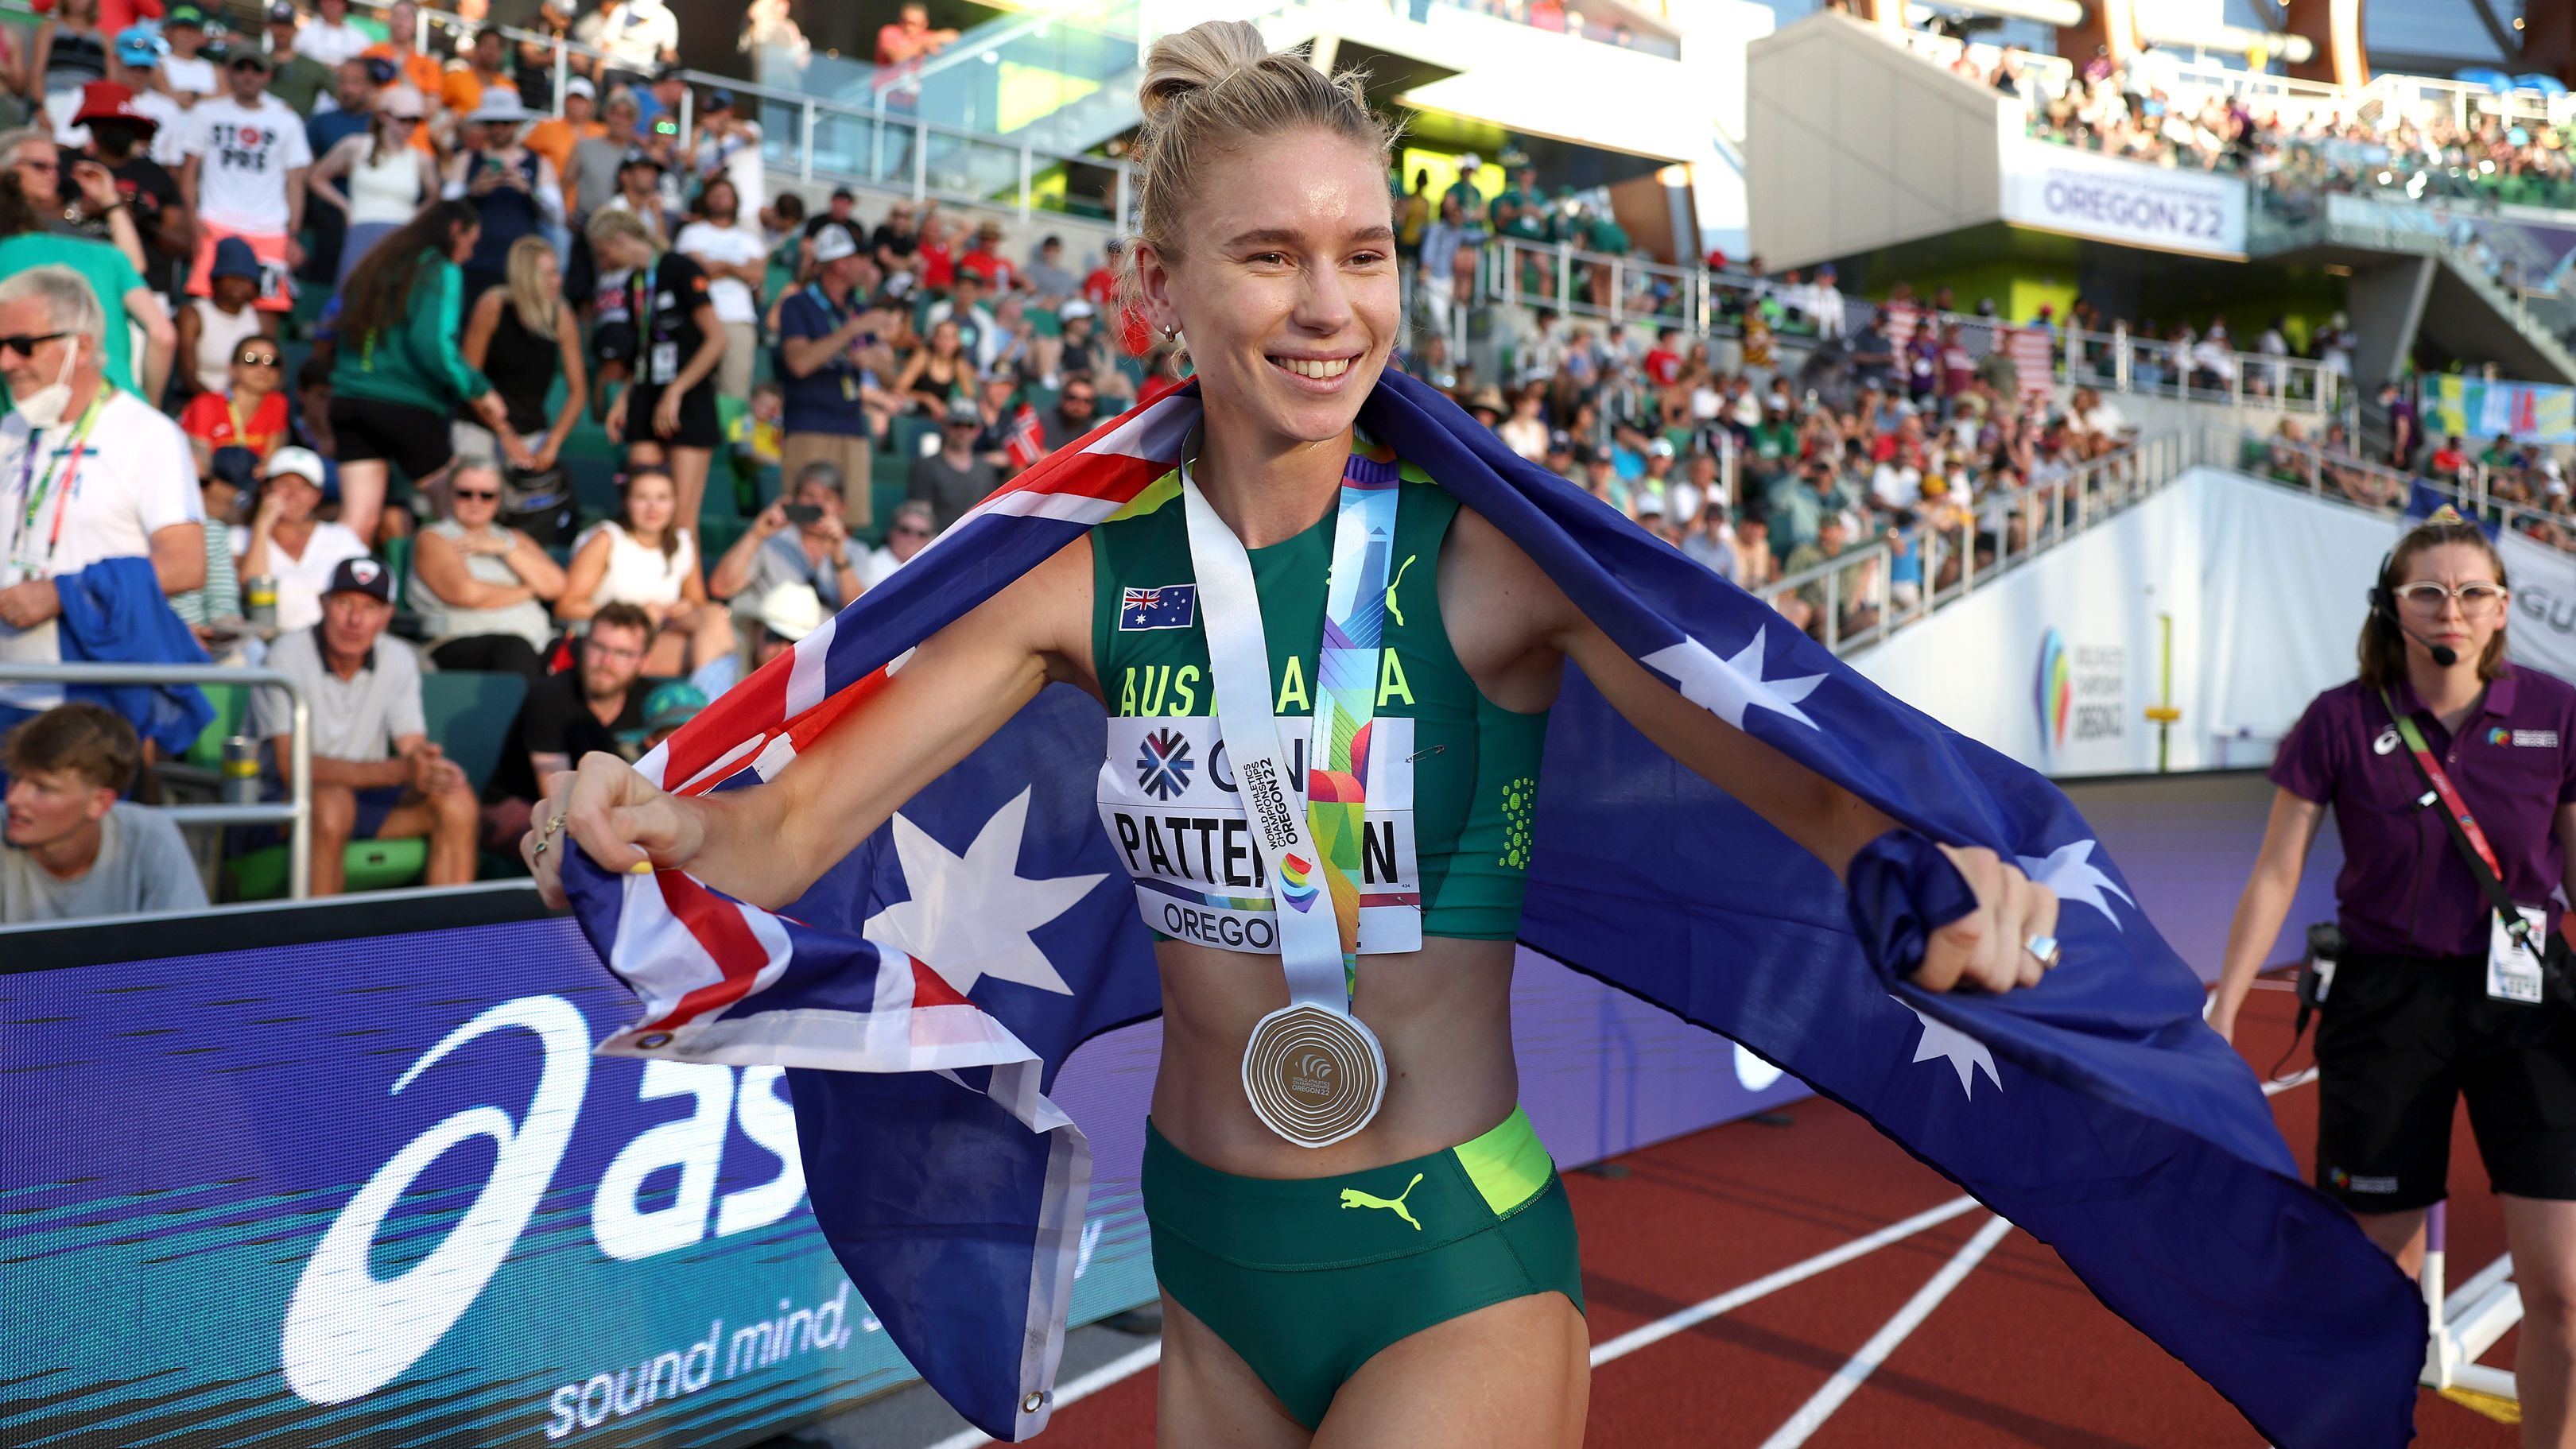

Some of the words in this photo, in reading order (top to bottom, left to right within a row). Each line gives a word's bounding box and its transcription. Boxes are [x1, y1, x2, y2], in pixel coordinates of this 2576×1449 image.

[211, 124, 277, 146] STOP
[222, 149, 266, 172] PRE
[2516, 583, 2576, 635] GU
[1119, 646, 1415, 718] AUSAA
[1243, 763, 1266, 813] ATHLETICS
[1251, 761, 1286, 847] CHAMPIONSHIPS
[1114, 812, 1399, 888] PATTEN
[1261, 816, 1278, 850] WORLD
[542, 1319, 723, 1440] sound
[724, 1279, 850, 1378] mind,
